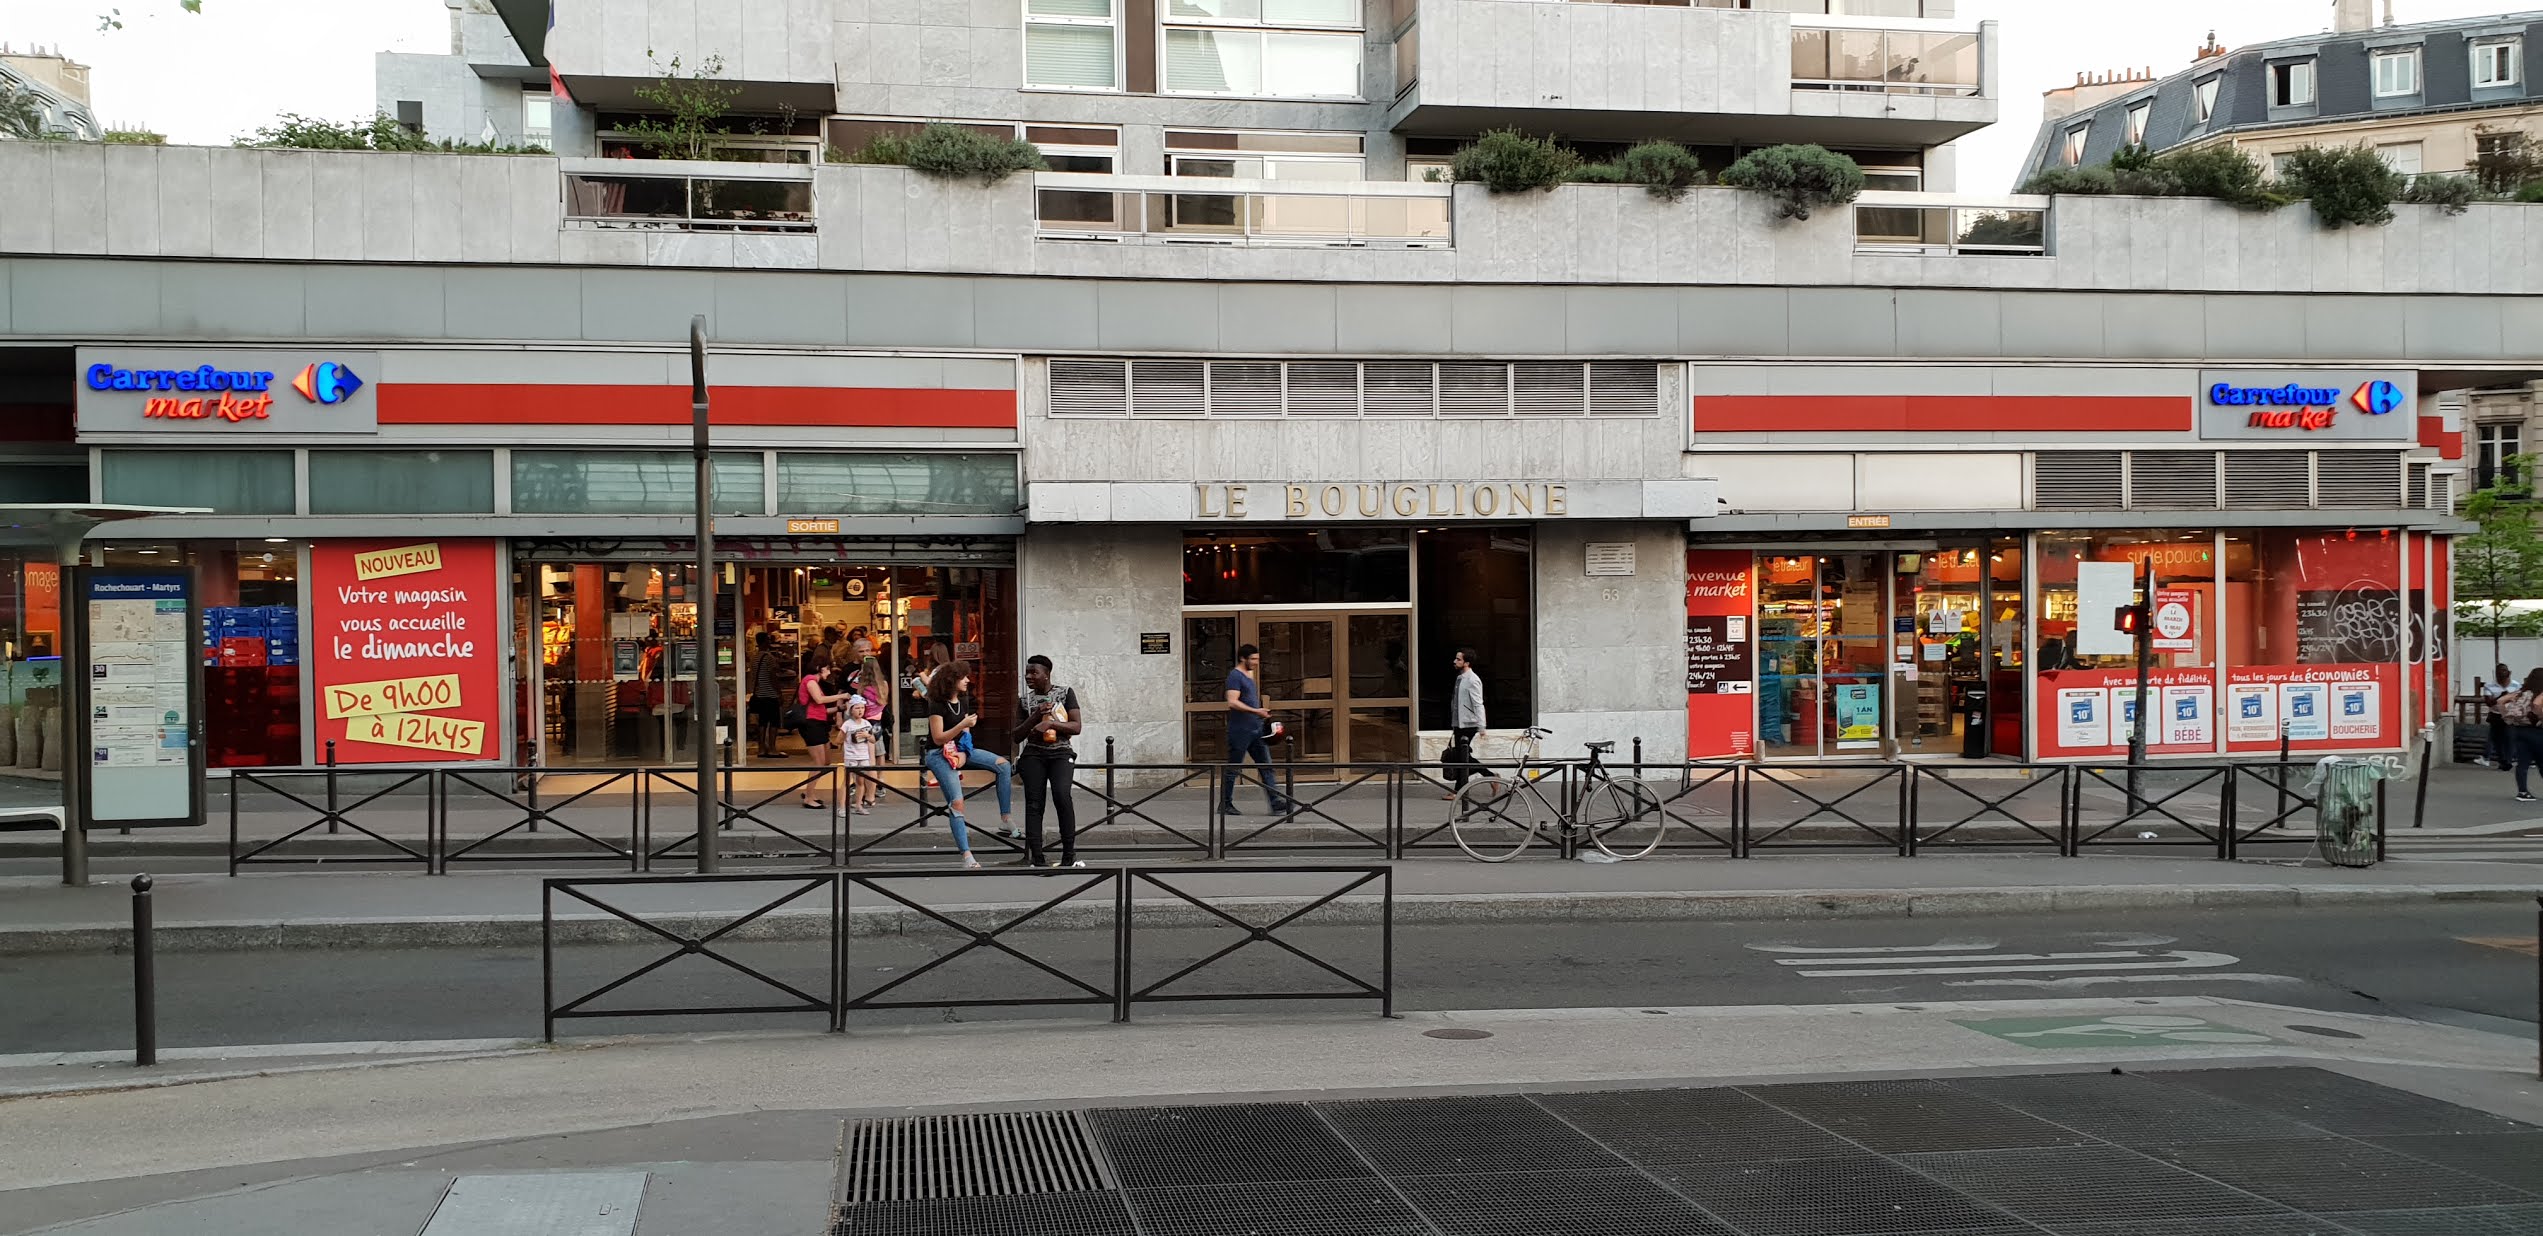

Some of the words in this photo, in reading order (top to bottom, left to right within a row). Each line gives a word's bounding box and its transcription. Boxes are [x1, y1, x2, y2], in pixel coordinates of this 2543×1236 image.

[86, 363, 275, 391] Carrefour
[2210, 382, 2341, 406] Carrefour
[143, 391, 274, 422] market
[2246, 405, 2339, 431] market
[1196, 484, 1248, 518] LE
[1284, 484, 1568, 518] BOUGLIONE
[791, 522, 836, 531] SORTIE
[1848, 516, 1889, 527] ENTRÉE
[360, 549, 436, 575] NOUVEAU
[25, 571, 58, 592] mage
[1687, 571, 1745, 581] nvenue
[94, 584, 145, 592] Rochechouart
[152, 583, 181, 593] Martyrs
[338, 585, 388, 605] Votre
[395, 587, 467, 610] magasin
[1603, 588, 1619, 601] 63
[1694, 583, 1747, 598] market
[1095, 595, 1114, 608] 63
[340, 618, 382, 633] vous
[389, 611, 466, 631] accueille
[333, 635, 352, 660] le
[361, 633, 474, 661] dimanche
[2103, 676, 2122, 686] Avec
[2165, 674, 2174, 685] de
[2232, 672, 2250, 682] tous
[2253, 672, 2264, 681] les
[2266, 672, 2288, 684] jours
[2290, 671, 2303, 682] des
[2305, 668, 2370, 683] économies
[334, 689, 372, 713] De
[382, 679, 451, 709] 9h00
[371, 714, 384, 738] à
[397, 718, 479, 750] 12h45
[2174, 726, 2202, 742] BÉBÉ
[2333, 724, 2377, 735] BOUCHERIE
